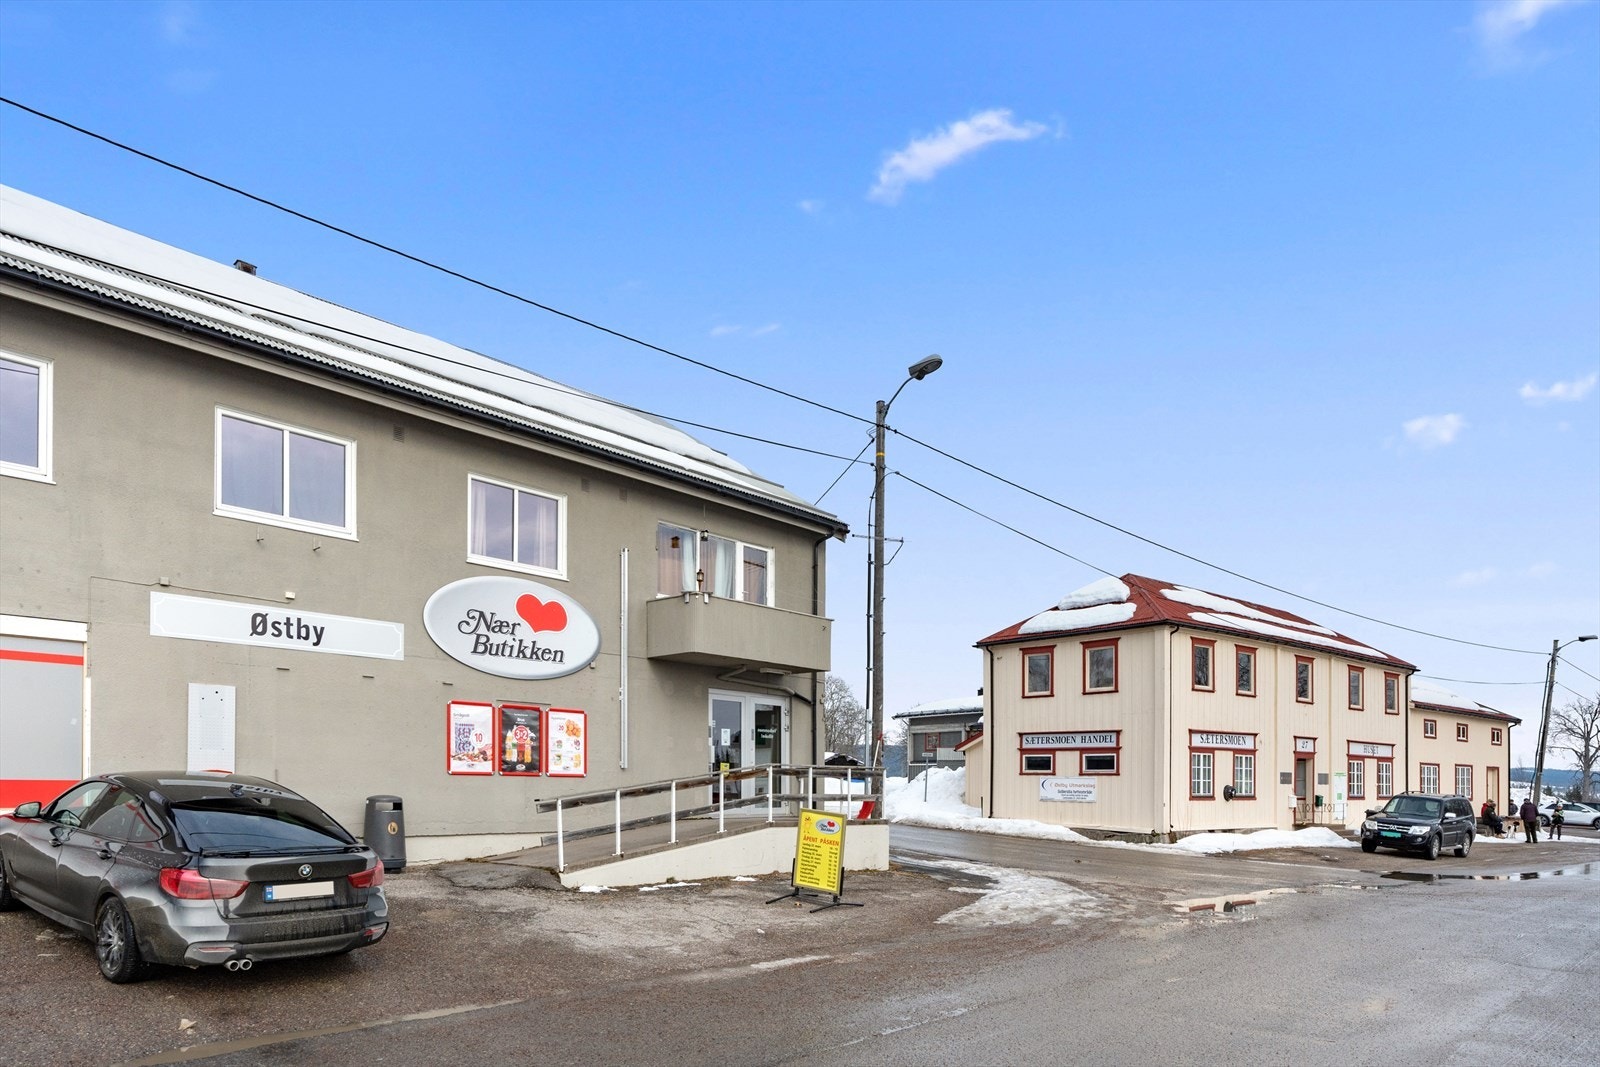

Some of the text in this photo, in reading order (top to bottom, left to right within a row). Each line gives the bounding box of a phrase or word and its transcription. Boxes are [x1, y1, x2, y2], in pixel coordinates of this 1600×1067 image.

[457, 608, 522, 636] Nær
[249, 612, 325, 646] Østby
[471, 633, 565, 665] Butikken
[474, 732, 483, 743] 10
[1025, 734, 1115, 745] SÆTERSMOEN HANDEL
[1199, 733, 1247, 746] SÆTERSMOEN
[1301, 740, 1309, 749] 27
[803, 834, 818, 842] ÅPENT
[820, 838, 839, 846] PÅSKEN
